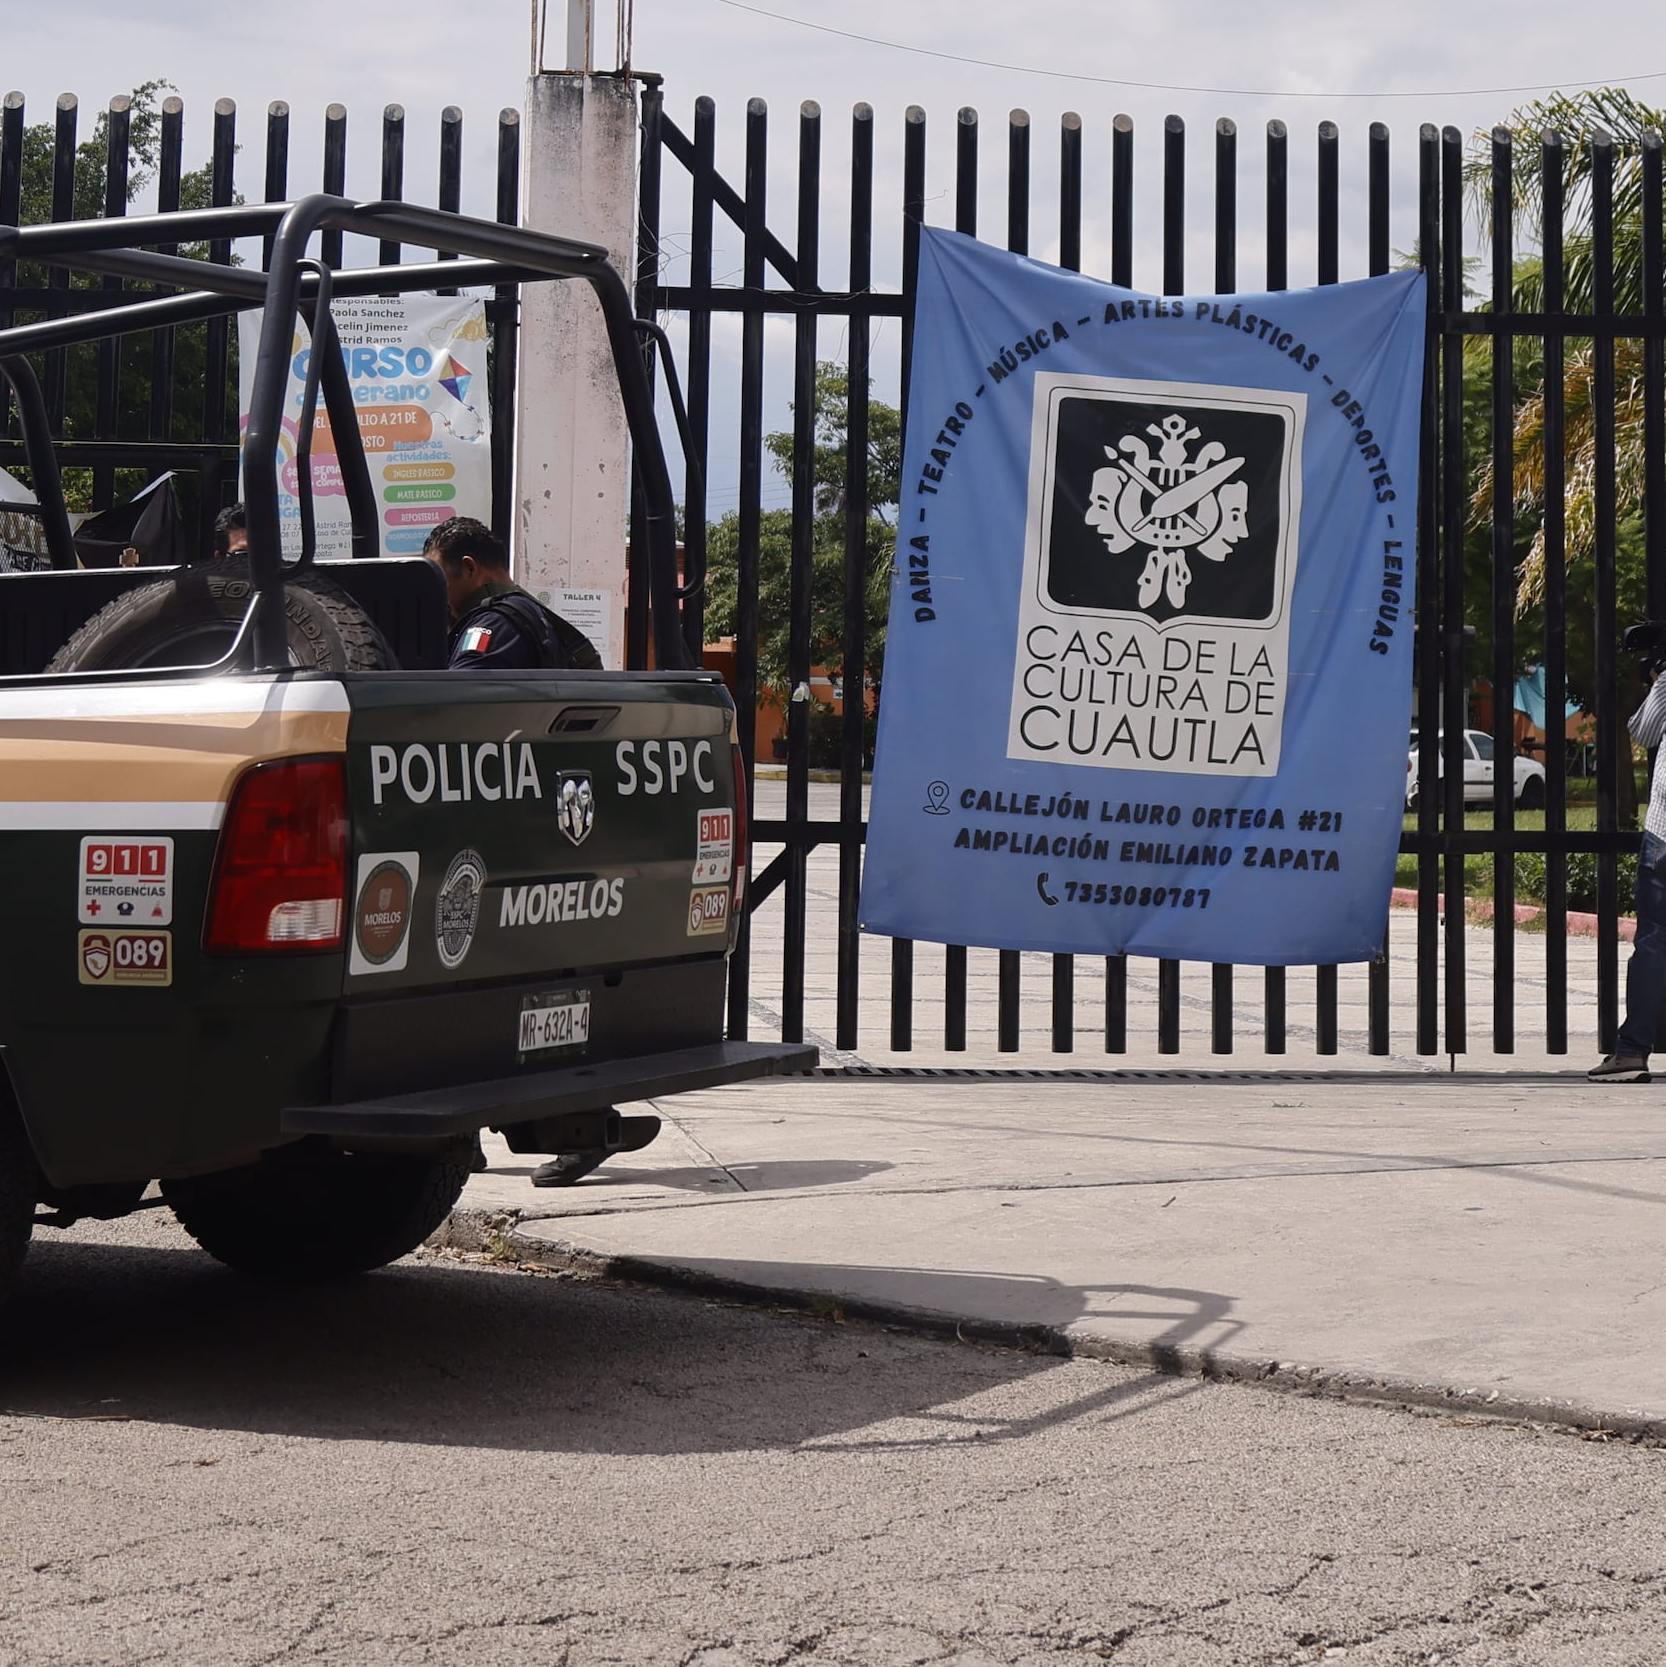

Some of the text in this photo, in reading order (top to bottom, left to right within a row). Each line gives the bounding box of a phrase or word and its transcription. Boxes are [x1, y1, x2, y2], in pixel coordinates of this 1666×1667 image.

[361, 308, 405, 319] Sanchez
[337, 322, 409, 333] celin Jimenez
[338, 335, 403, 345] strid Ramos
[354, 383, 430, 404] erano
[391, 412, 402, 425] 21
[405, 411, 418, 424] DE
[386, 450, 452, 462] actividades:
[909, 298, 1404, 656] DANZA TEATRO MÚSICA ARTES PLÁSTICAS DEPORTES LENGUAS
[1026, 625, 1275, 678] CASA DE LA
[1023, 663, 1276, 716] CULTURA DE
[1020, 704, 1266, 766] CUAUTLA
[371, 730, 542, 805] POLICÍA
[615, 740, 716, 796] SSPC
[960, 788, 1343, 833] CALLEJÓN LAURO ORTEGA #21
[701, 818, 729, 840] 911
[92, 849, 159, 872] 911
[699, 849, 730, 861] EMERGENCIAS
[954, 827, 1341, 872] AMPLIACIÓN EMILIANO ZAPATA
[85, 885, 166, 897] EMERGENCIAS
[499, 877, 624, 928] MORELOS
[1064, 881, 1211, 909] 7353080787
[704, 892, 726, 918] 089
[364, 911, 402, 927] MORELOS
[116, 938, 165, 967] 089
[520, 1005, 589, 1049] MR-632A-4
